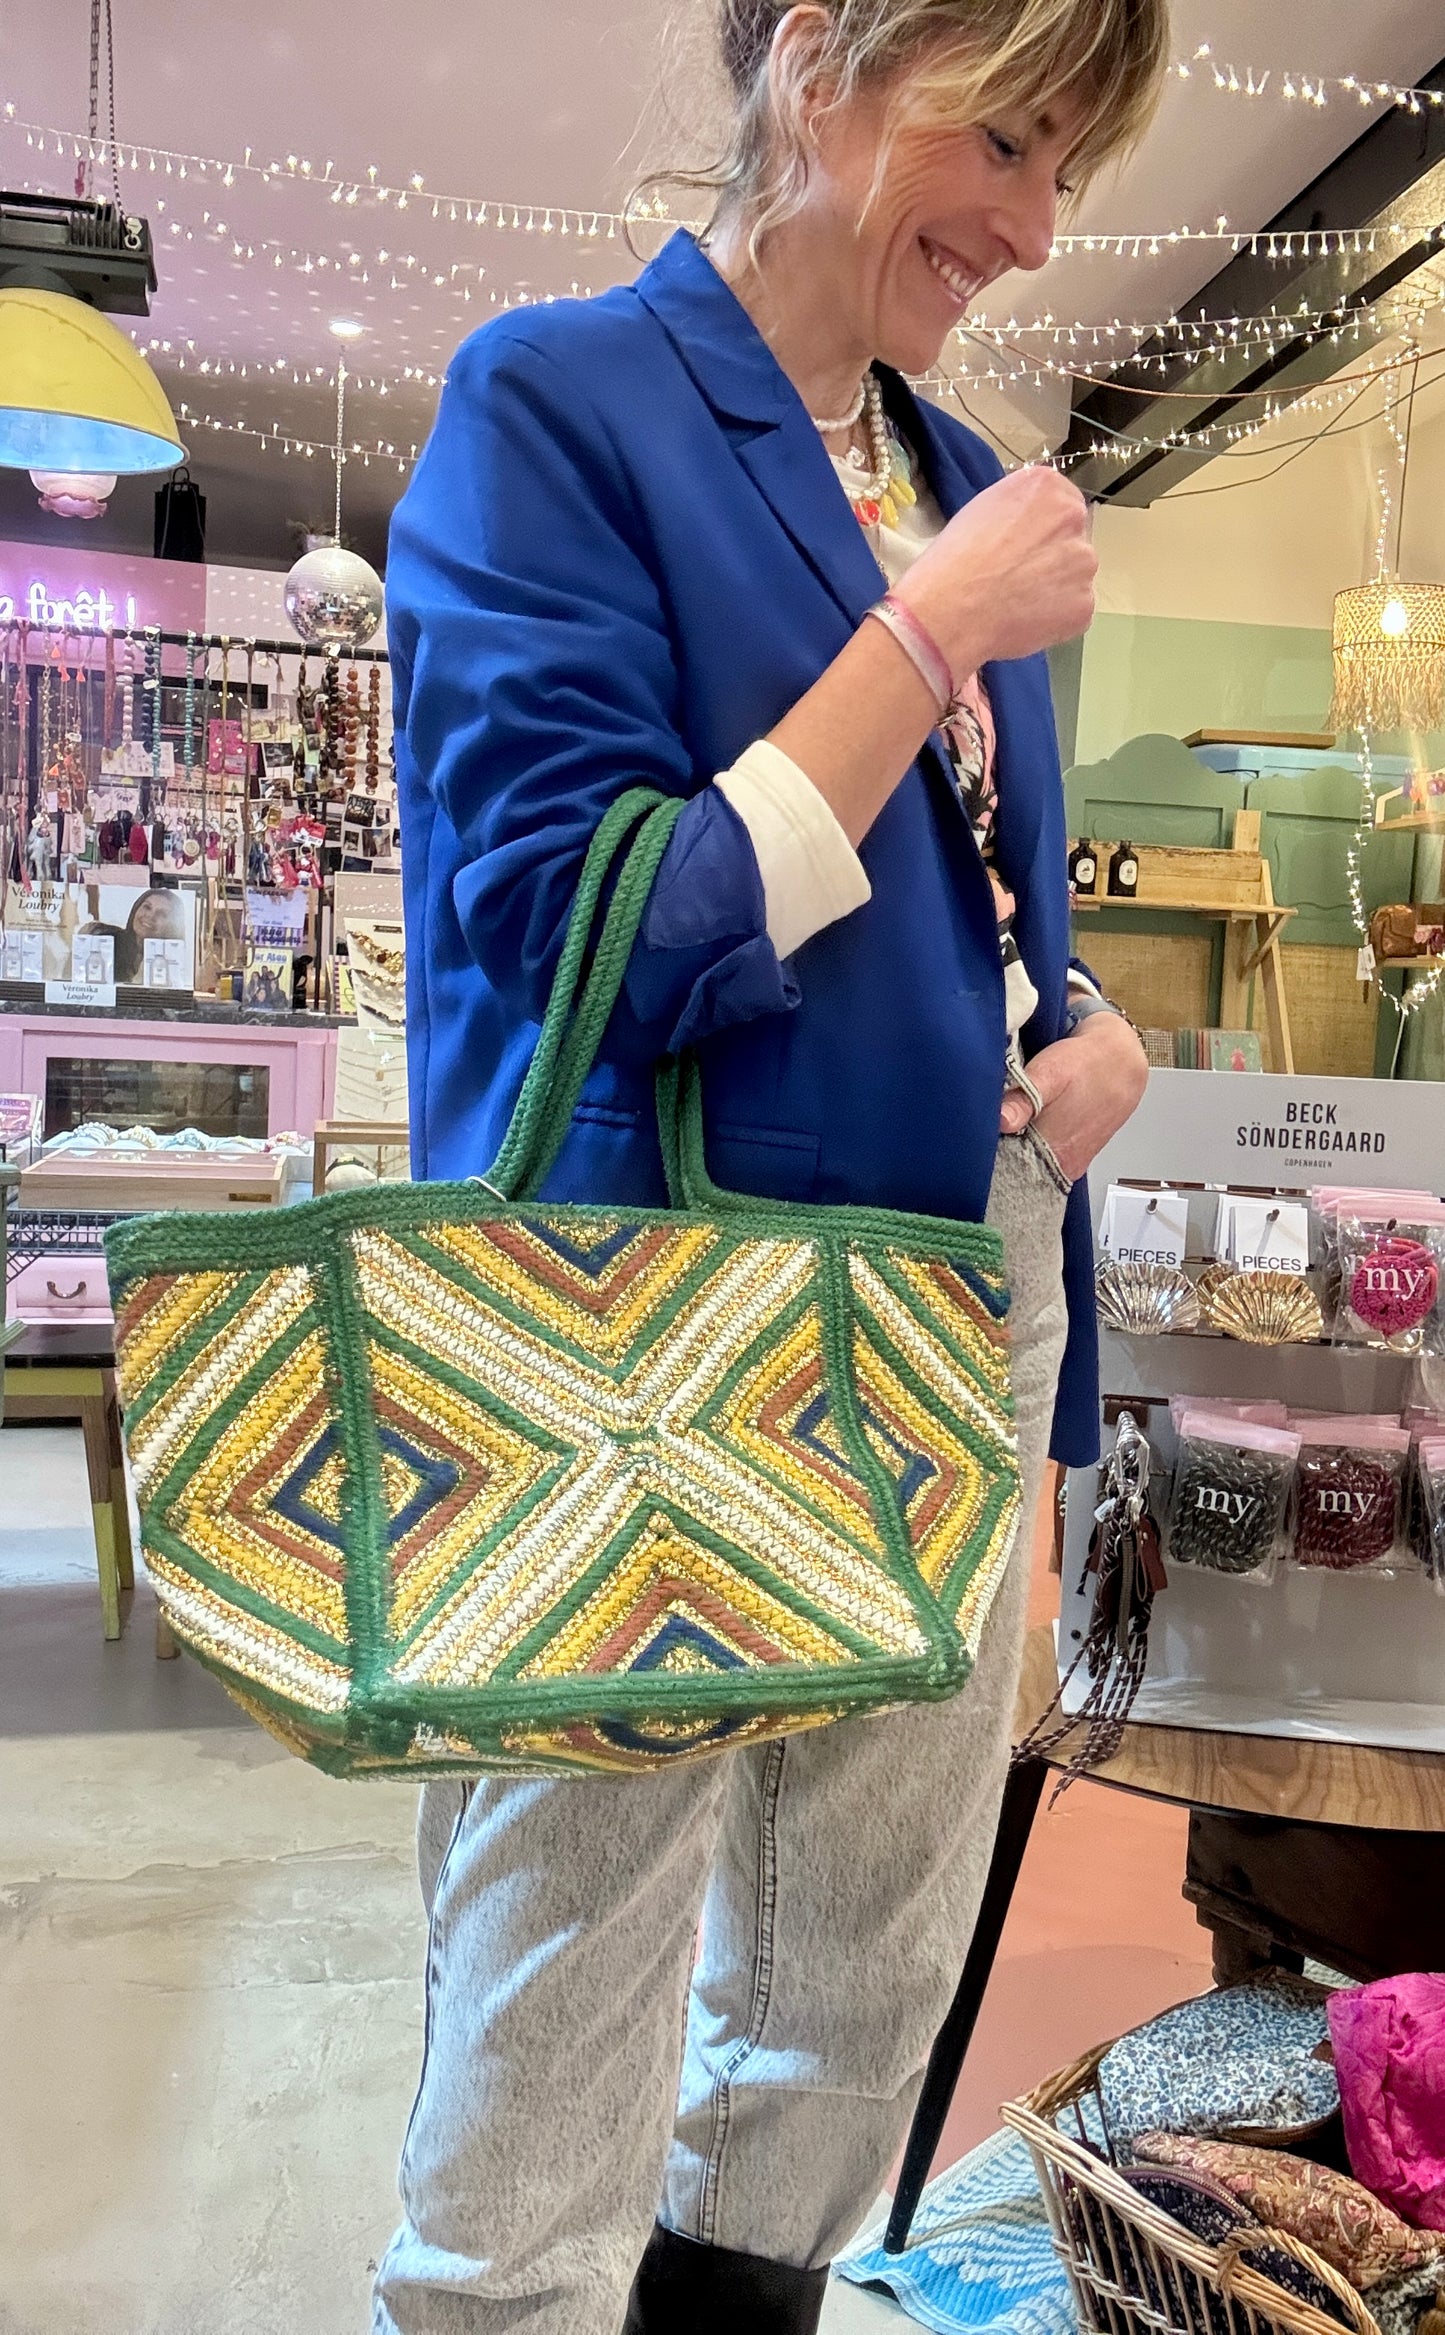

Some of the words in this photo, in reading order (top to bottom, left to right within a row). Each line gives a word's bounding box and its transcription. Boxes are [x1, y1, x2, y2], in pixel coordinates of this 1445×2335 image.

[29, 582, 114, 630] forêt
[18, 899, 60, 913] Loubry
[62, 984, 98, 993] Veronika
[66, 992, 95, 1001] Loubry
[1286, 1102, 1337, 1124] BECK
[1236, 1121, 1385, 1153] SÖNDERGAARD
[1284, 1158, 1332, 1168] COPENHAGEN
[1118, 1247, 1177, 1265] PIECES
[1242, 1255, 1302, 1271] PIECES
[1364, 1267, 1424, 1301] my
[1194, 1486, 1255, 1524] my
[1317, 1489, 1375, 1523] my
